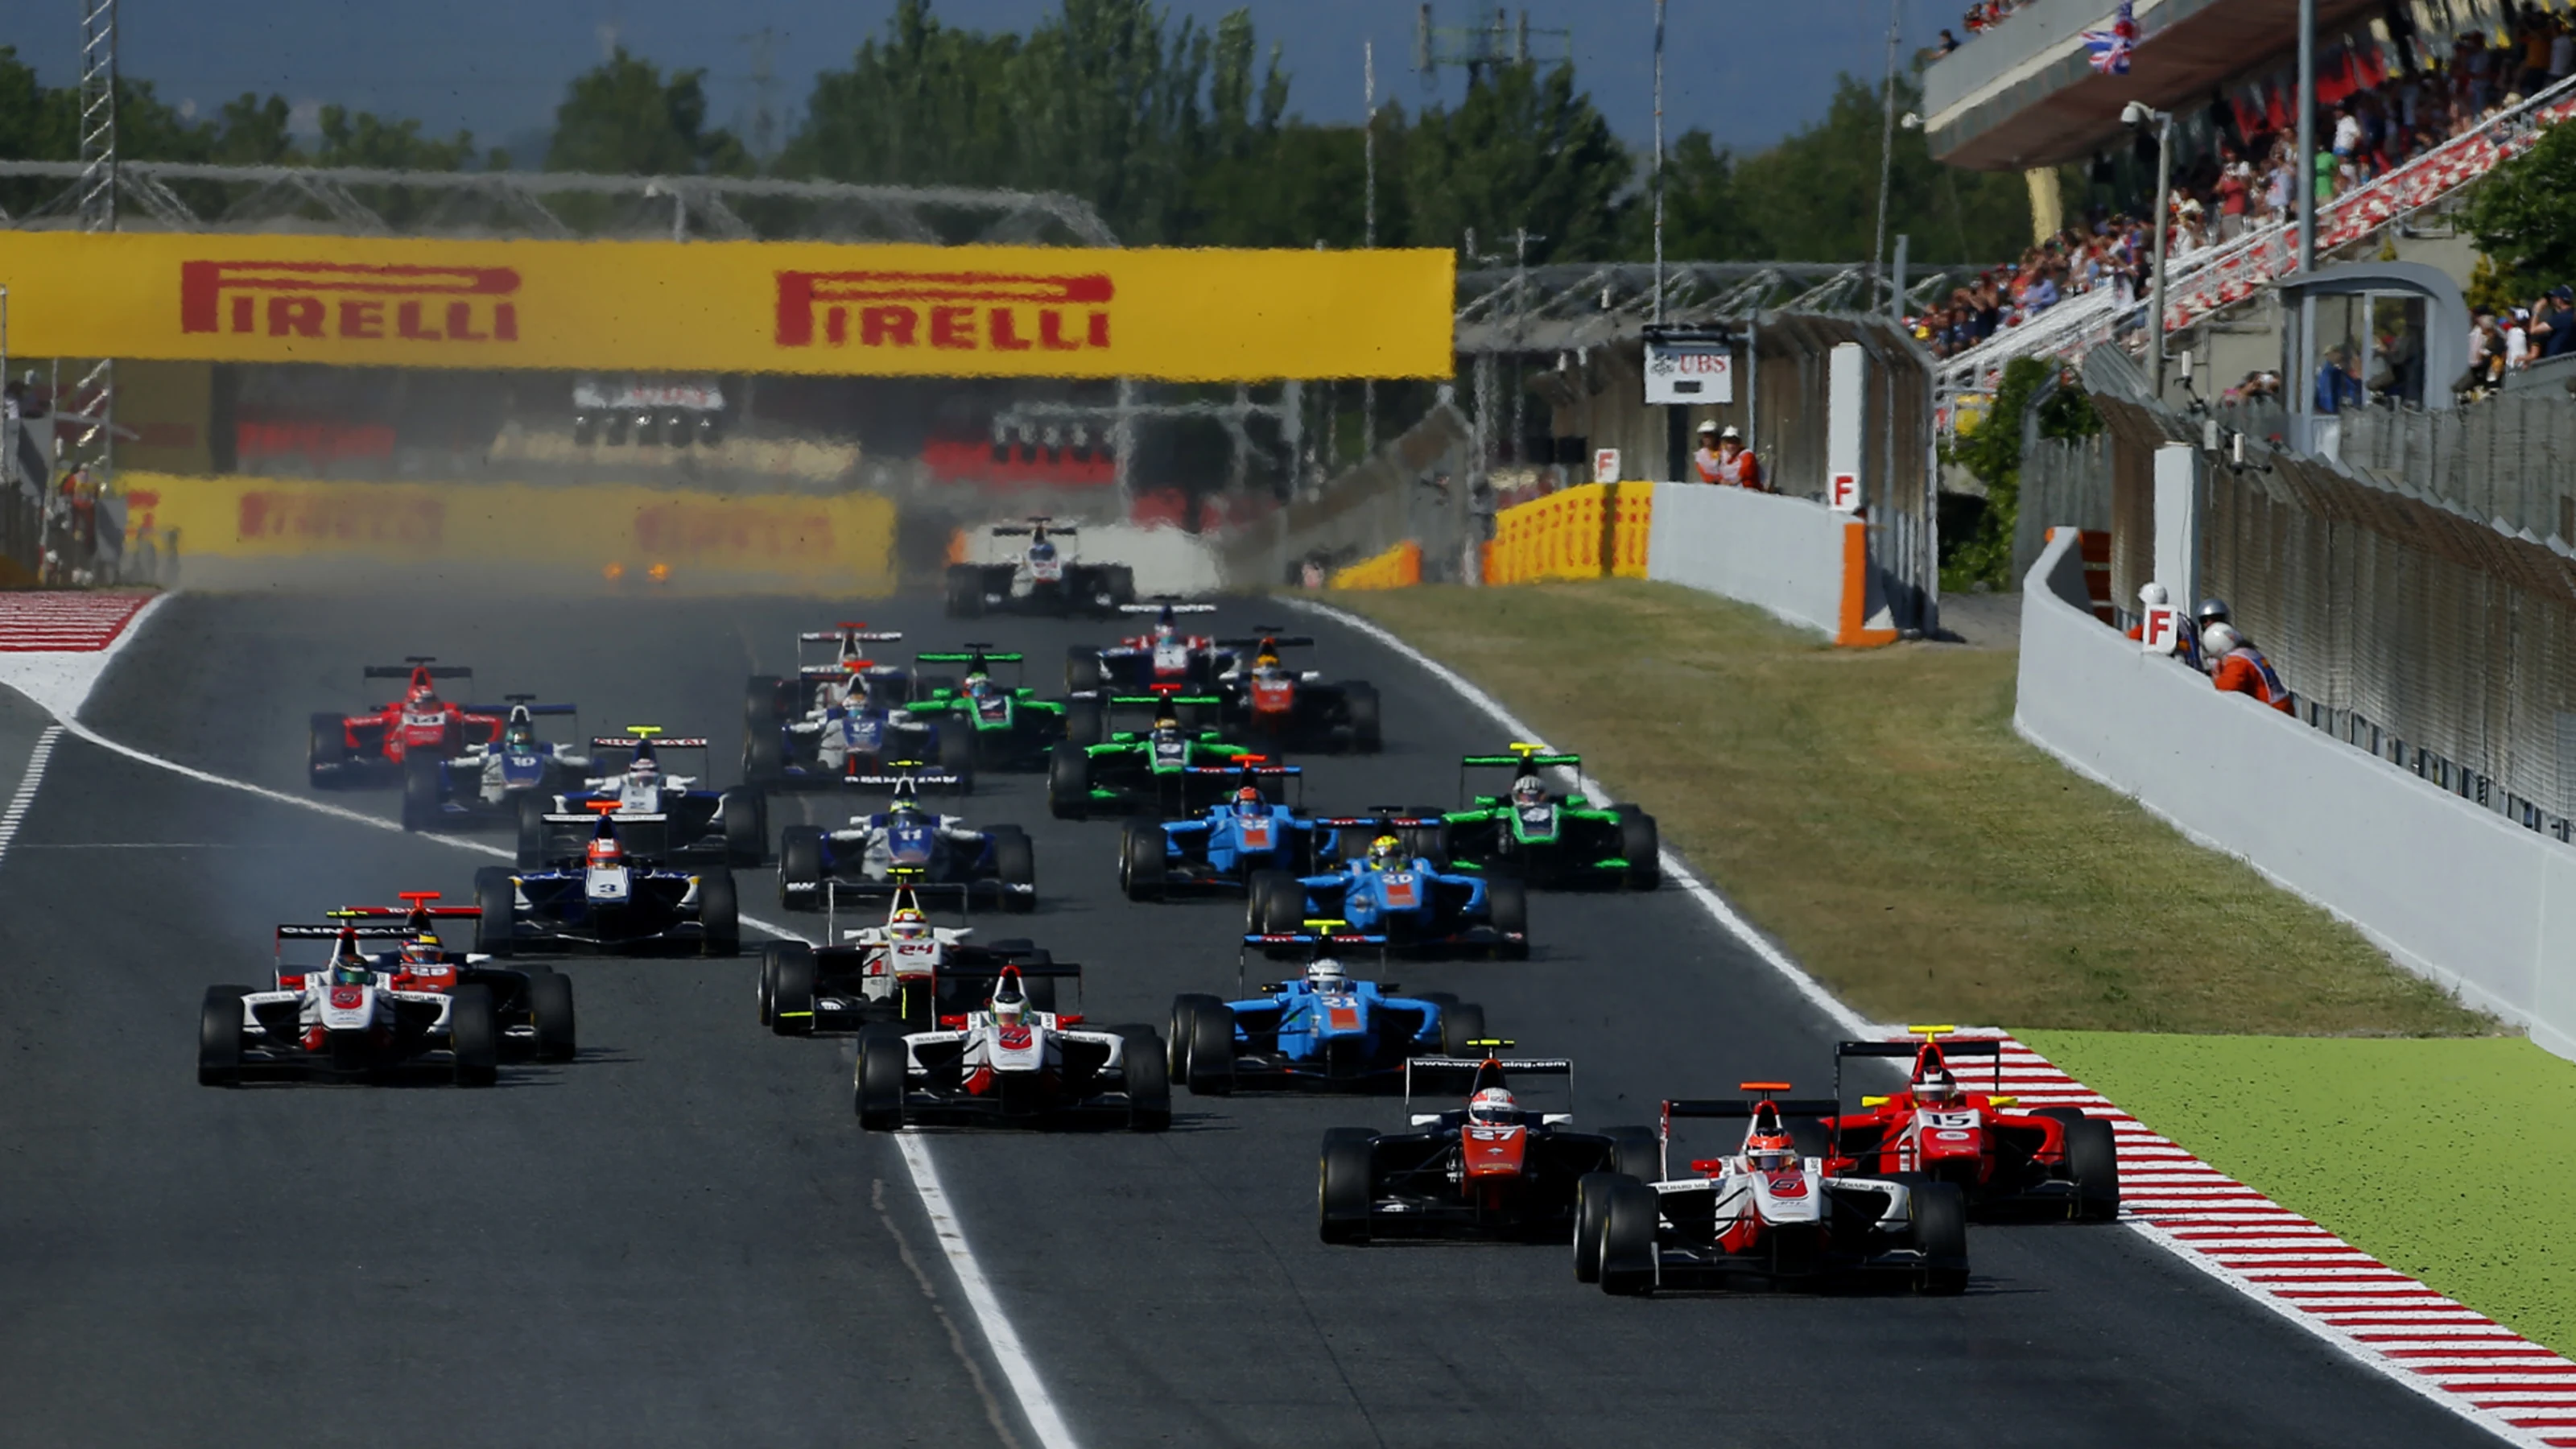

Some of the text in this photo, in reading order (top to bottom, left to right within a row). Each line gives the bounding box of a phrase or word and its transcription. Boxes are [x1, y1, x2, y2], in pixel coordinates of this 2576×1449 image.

[182, 261, 520, 341] PIRELLI
[776, 270, 1114, 349] PIRELLI
[1680, 355, 1725, 374] UBS
[1599, 452, 1614, 477] F
[1835, 476, 1853, 505] F
[2149, 610, 2170, 645] F
[1381, 873, 1414, 885] 20
[599, 884, 616, 893] 3
[898, 943, 934, 956] 24
[1321, 997, 1358, 1008] 21
[1926, 1113, 1970, 1126] 15
[1472, 1129, 1516, 1141] 27
